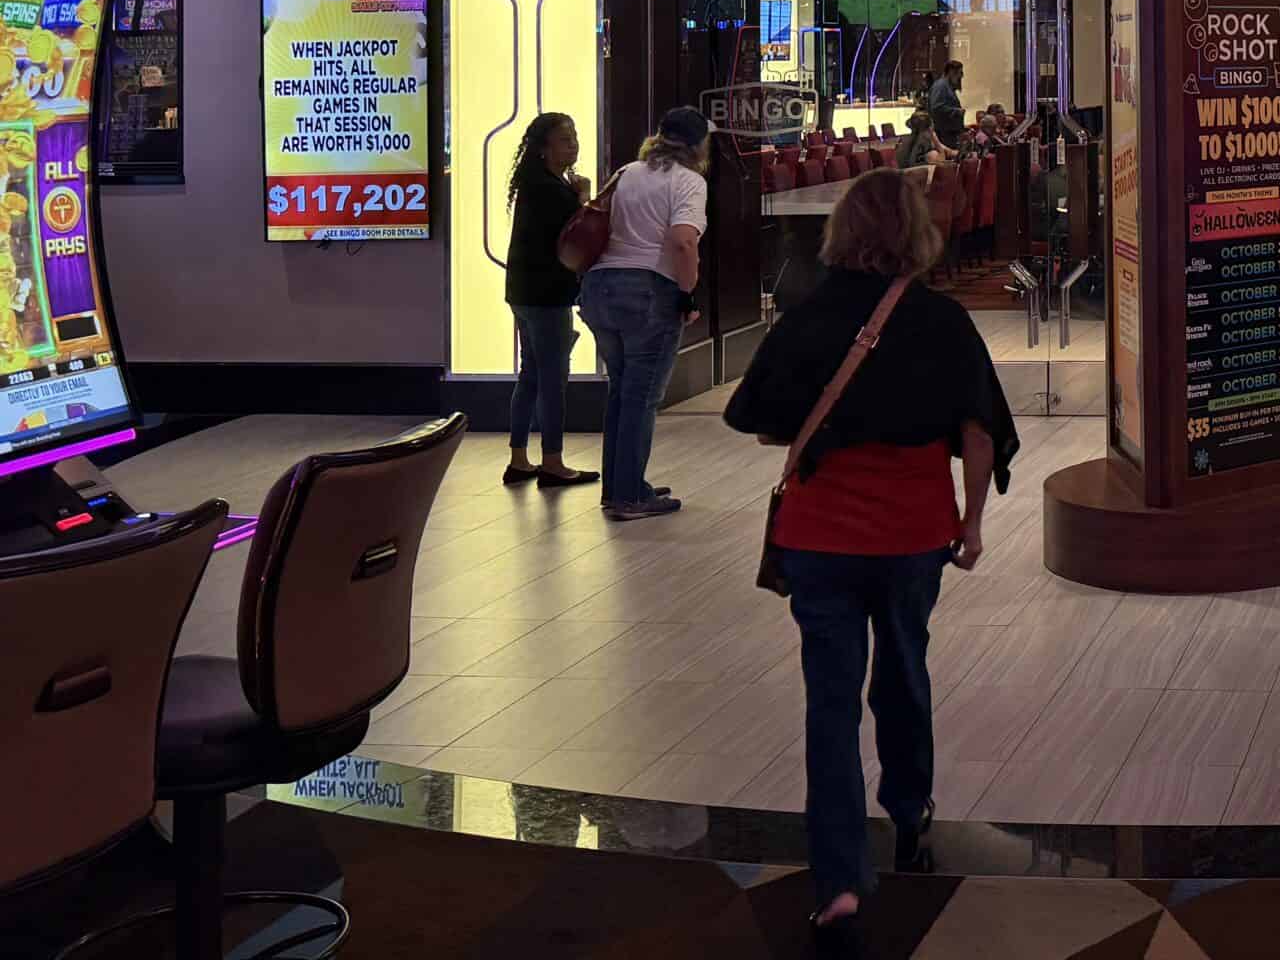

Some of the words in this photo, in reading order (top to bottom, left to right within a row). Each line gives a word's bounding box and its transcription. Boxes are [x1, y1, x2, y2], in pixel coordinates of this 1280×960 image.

[3, 2, 40, 26] SPINS
[1208, 14, 1270, 36] ROCK
[292, 42, 333, 58] WHEN
[336, 40, 398, 57] JACKPOT
[1219, 39, 1277, 61] SHOT
[314, 60, 346, 78] HITS,
[351, 59, 376, 75] ALL
[1220, 71, 1262, 84] BINGO
[275, 79, 349, 96] REMAINING
[353, 77, 417, 94] REGULAR
[313, 98, 360, 114] GAMES
[364, 97, 377, 113] IN
[710, 98, 805, 121] BINGO
[1198, 97, 1237, 127] WIN
[296, 118, 330, 133] THAT
[334, 116, 391, 132] SESSION
[282, 136, 308, 152] ARE
[312, 135, 362, 151] WORTH
[366, 134, 410, 154] $1,000
[1199, 135, 1222, 160] TO
[45, 161, 79, 180] ALL
[269, 184, 426, 217] $117,202
[46, 236, 86, 256] PAYS
[1221, 243, 1275, 258] OCTOBER
[1221, 261, 1276, 278] OCTOBER
[1221, 285, 1277, 303] OCTOBER
[1221, 307, 1275, 325] OCTOBER
[1222, 325, 1276, 344] OCTOBER
[1222, 350, 1276, 368] OCTOBER
[40, 383, 49, 397] TO
[1222, 373, 1276, 393] OCTOBER
[1187, 417, 1210, 442] $35
